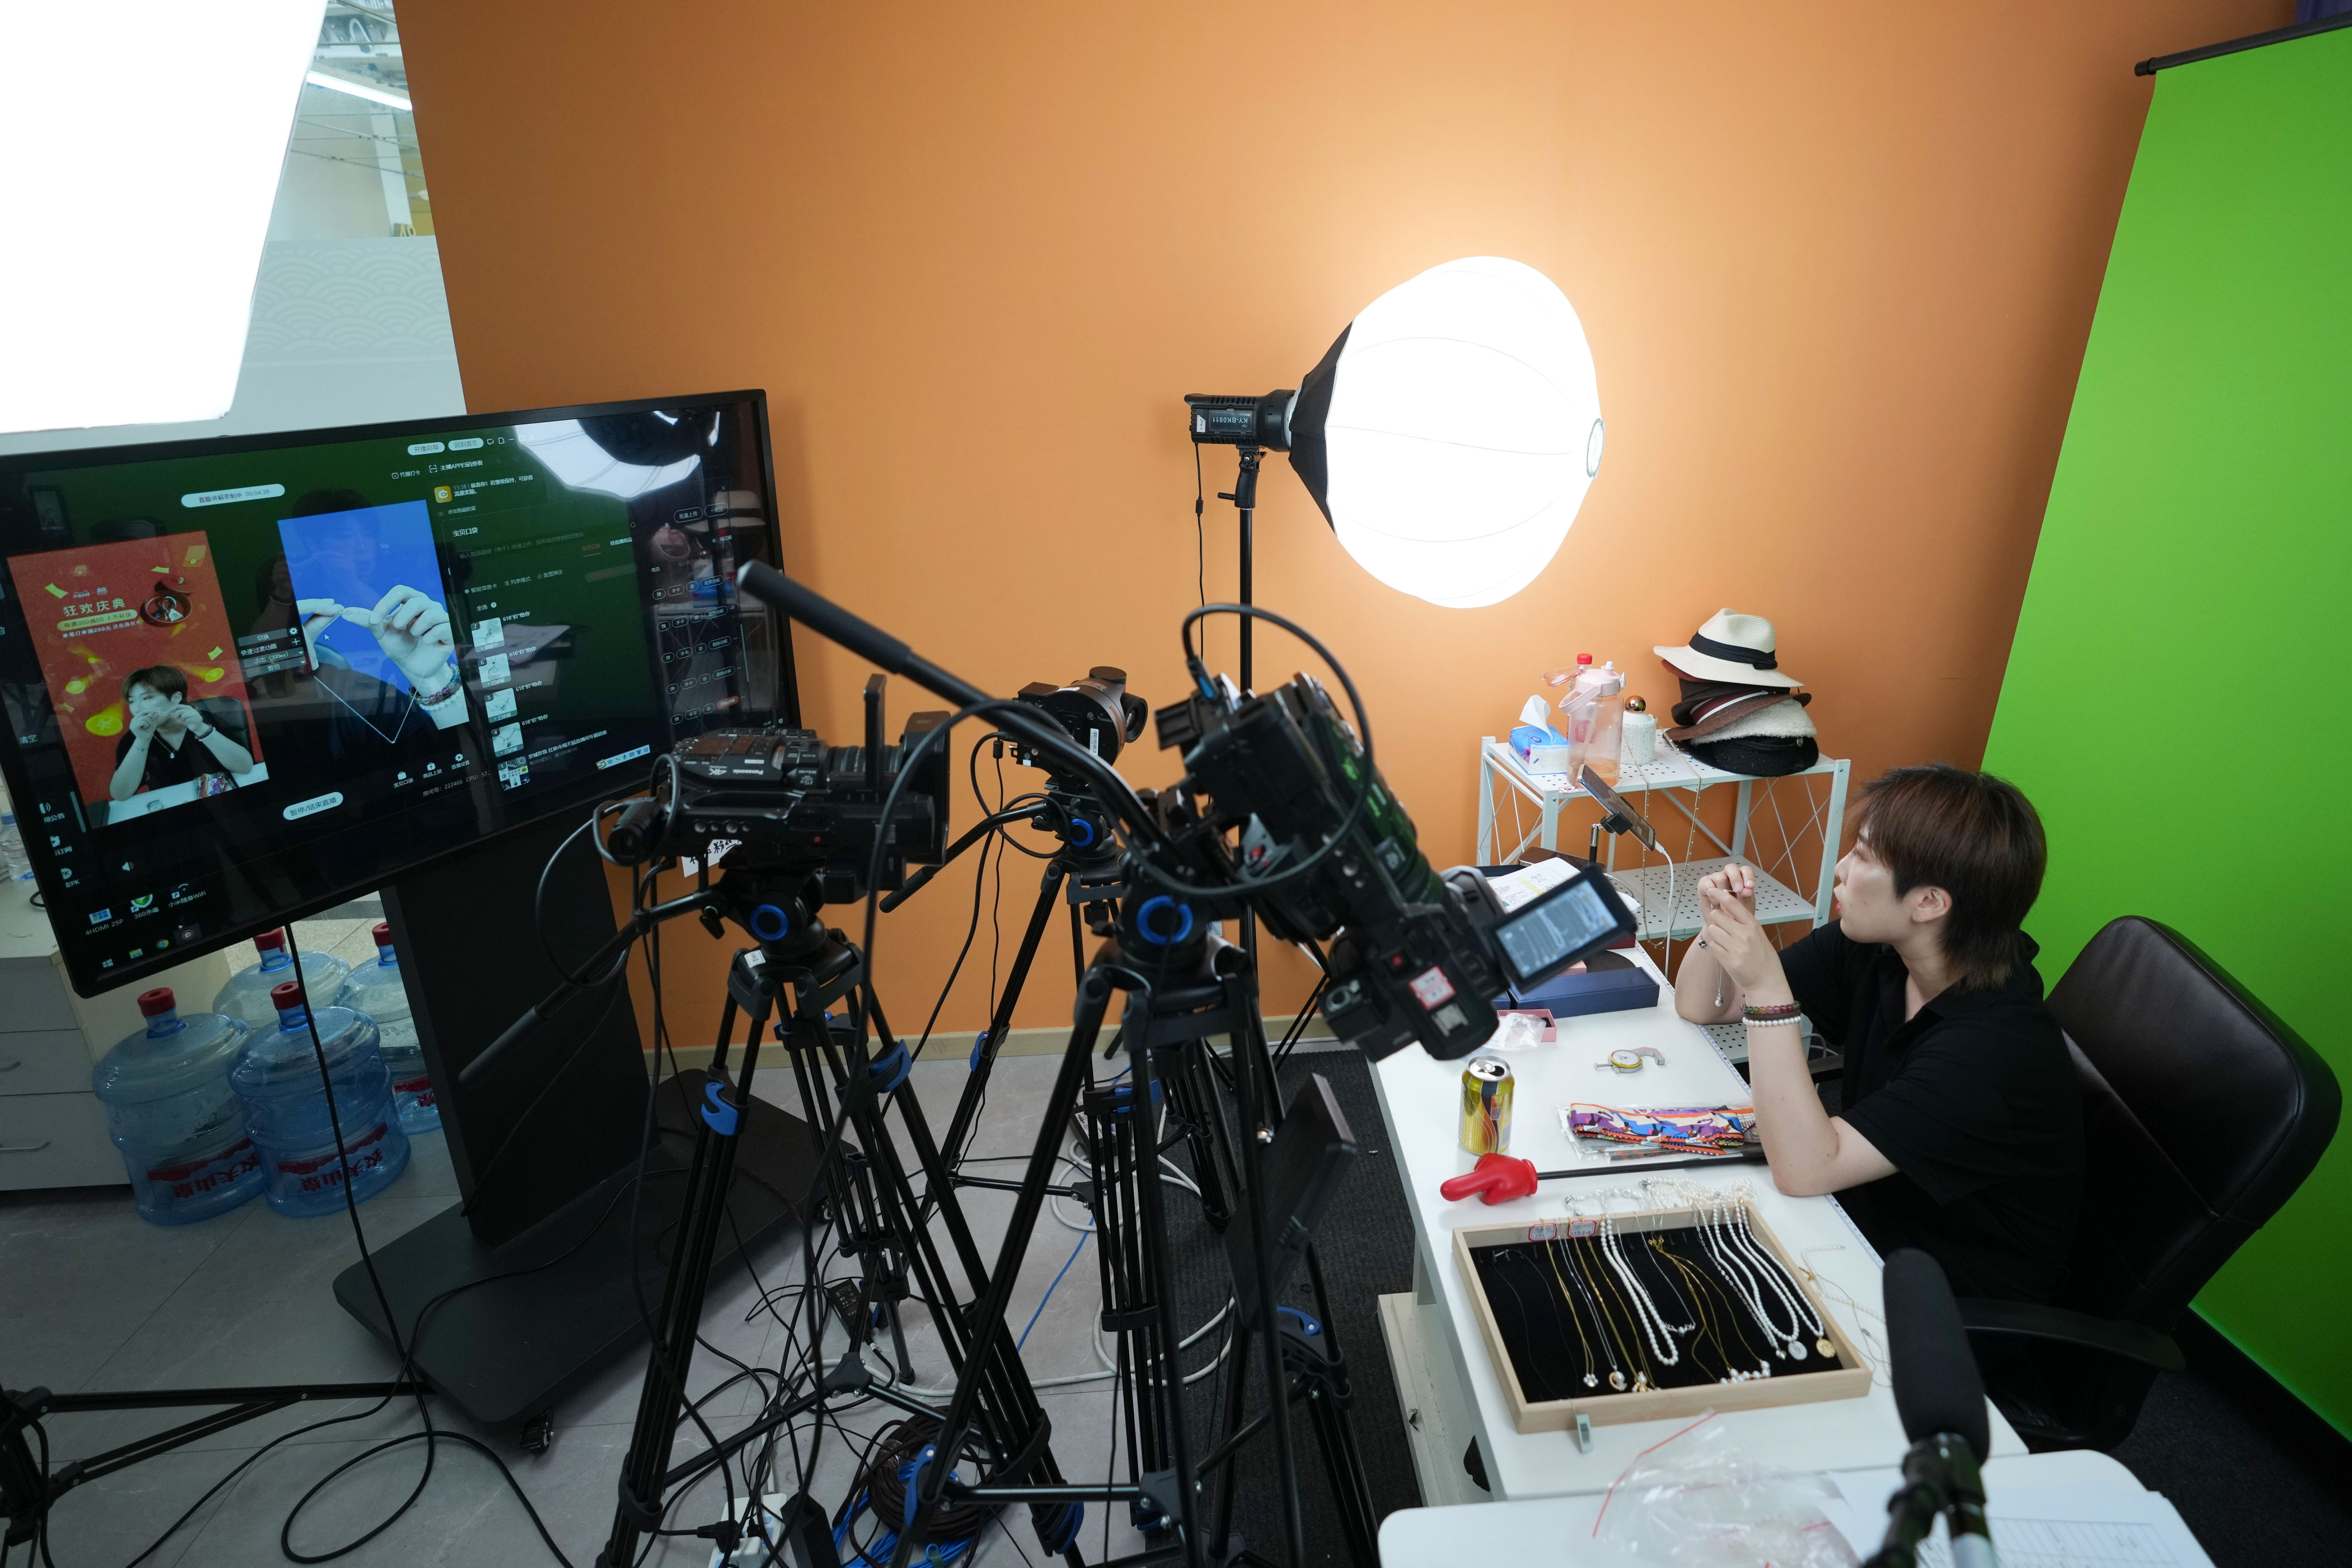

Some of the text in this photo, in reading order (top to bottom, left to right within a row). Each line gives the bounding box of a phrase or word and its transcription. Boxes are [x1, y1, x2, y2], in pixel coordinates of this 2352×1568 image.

[414, 445, 439, 453] 开播向导
[455, 440, 478, 448] 回到首页
[199, 493, 242, 503] 直播讲解录制中
[679, 511, 698, 519] 批量上传
[453, 527, 478, 537] 宝贝口袋
[510, 576, 531, 585] 列表模式
[471, 583, 497, 593] 智能信息卡
[63, 598, 126, 617] 狂欢庆典
[708, 768, 727, 776] 4K
[444, 779, 463, 790] 222466
[290, 797, 337, 816] 暂停/结束直播
[111, 918, 123, 928] 25P
[300, 1148, 383, 1192] 农夫山泉
